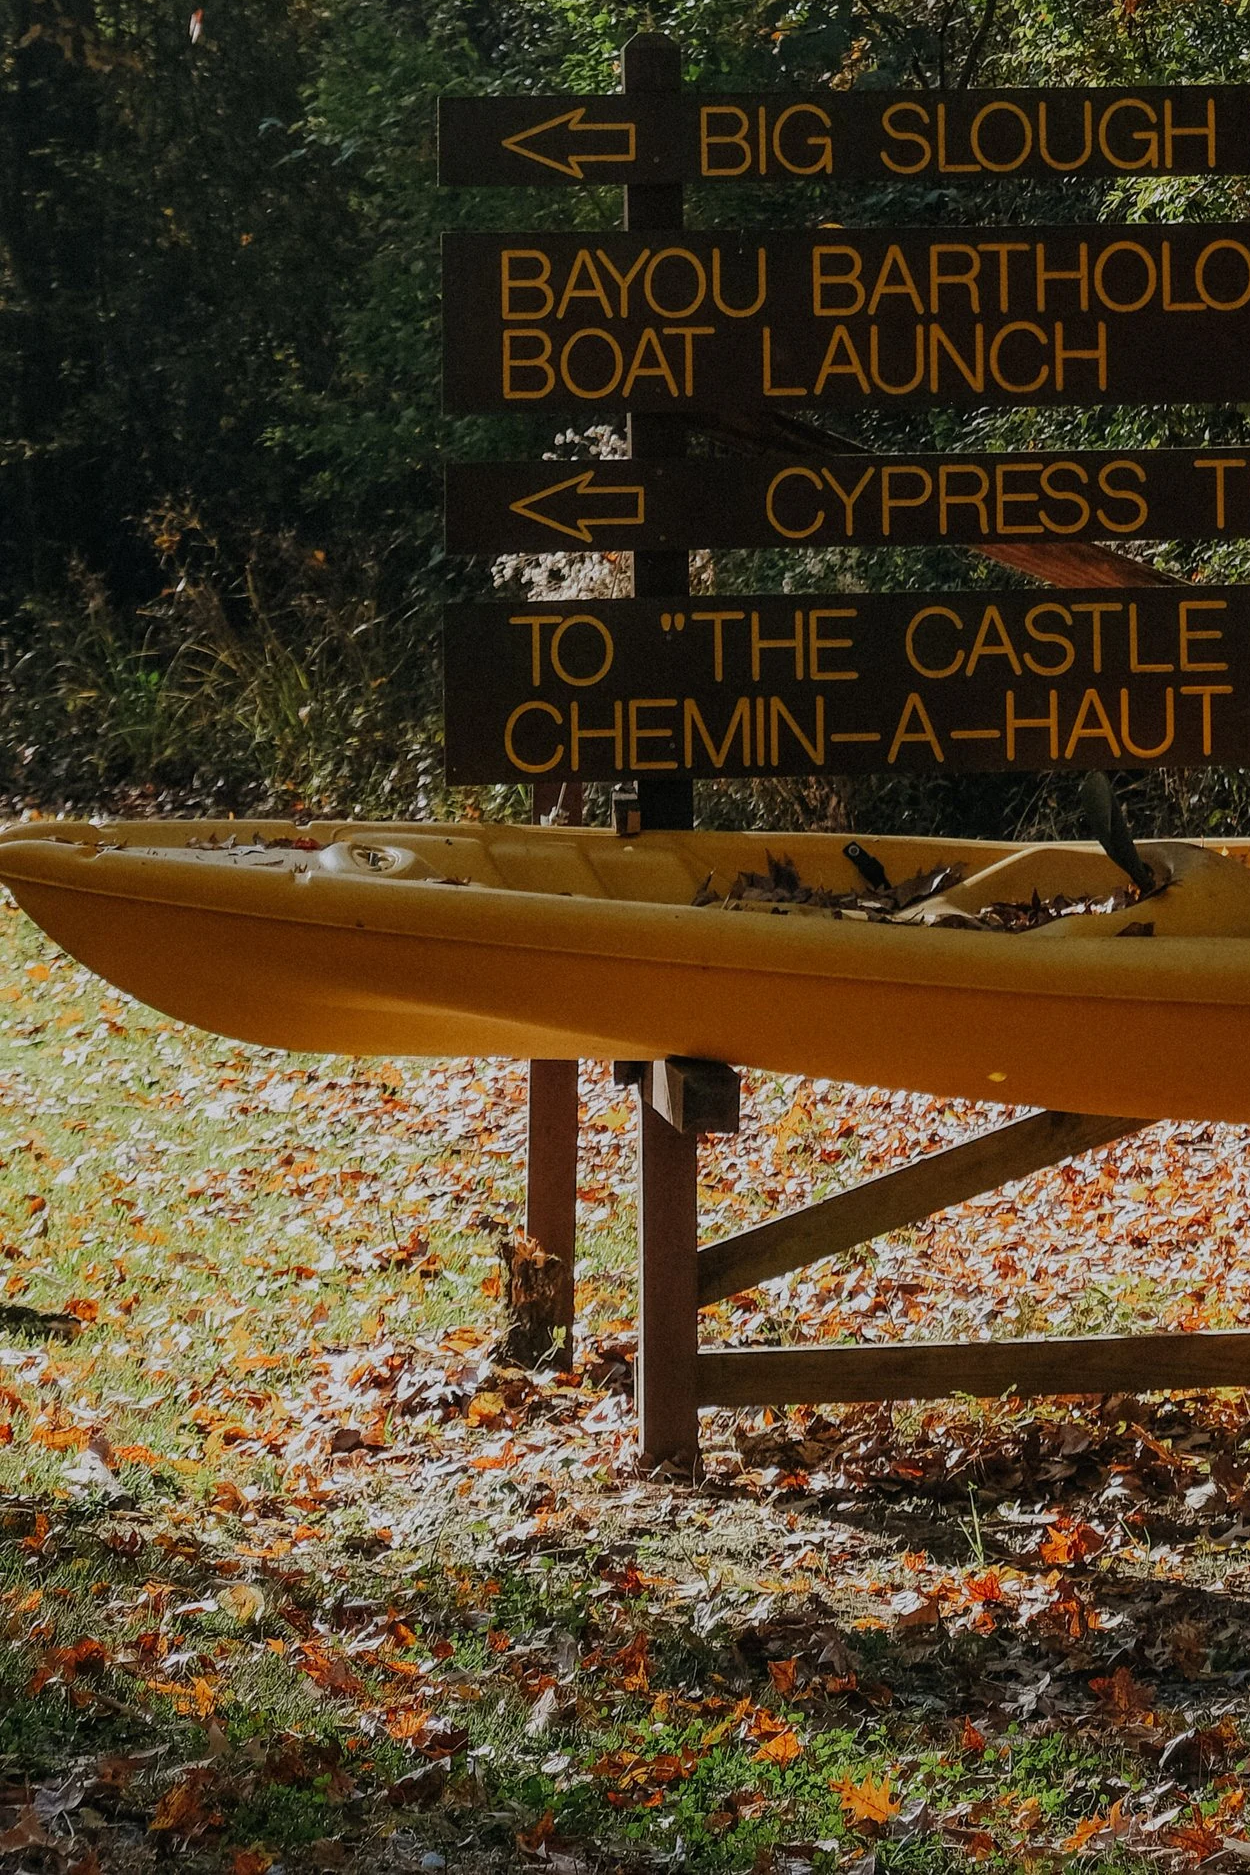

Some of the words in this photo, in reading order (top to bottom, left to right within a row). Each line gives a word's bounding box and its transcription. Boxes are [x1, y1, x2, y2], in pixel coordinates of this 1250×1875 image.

[700, 102, 834, 176] BIG
[880, 98, 1217, 175] SLOUGH
[501, 247, 767, 320] BAYOU
[502, 327, 715, 400] BOAT
[763, 321, 1108, 397] LAUNCH
[766, 460, 1149, 538] CYPRESS
[510, 614, 614, 686] TO
[660, 609, 859, 681] "THE
[905, 600, 1229, 678] CASTLE
[504, 685, 1233, 773] CHEMIN-A-HAUT
